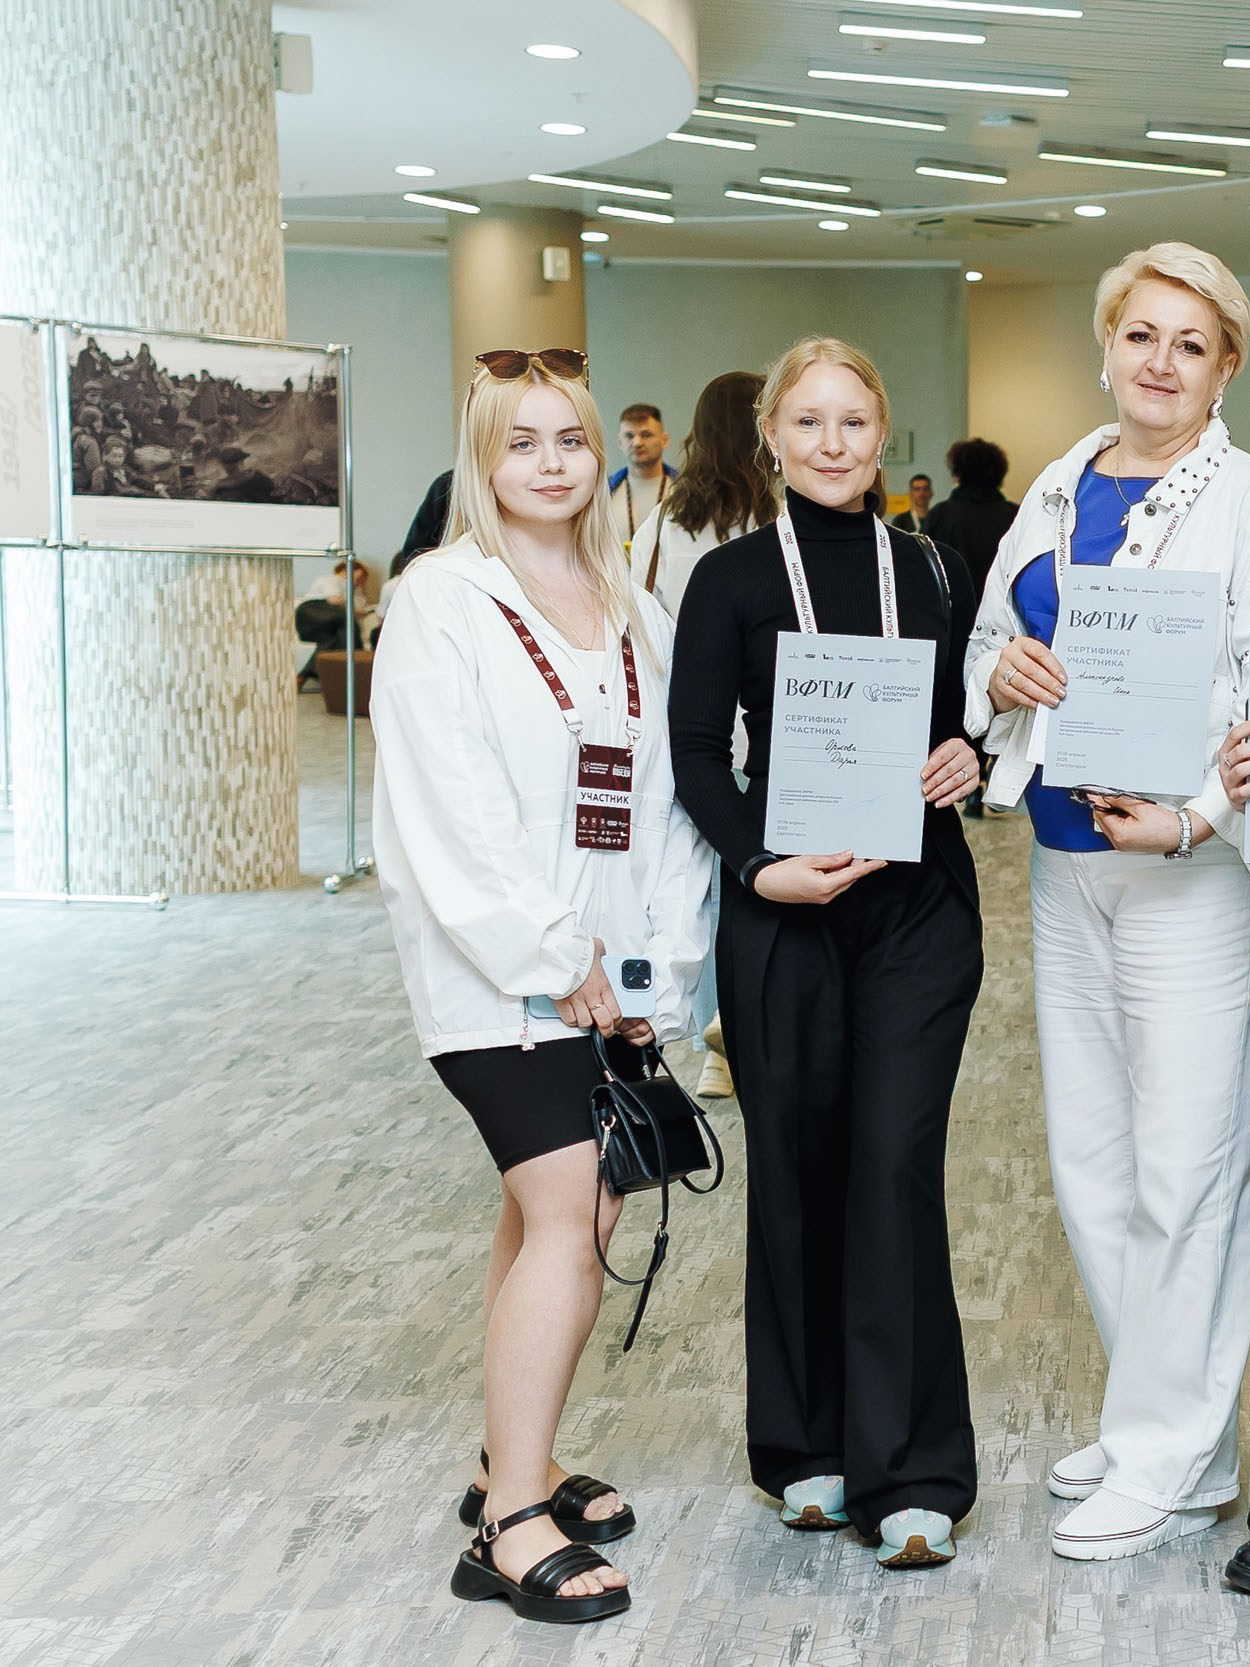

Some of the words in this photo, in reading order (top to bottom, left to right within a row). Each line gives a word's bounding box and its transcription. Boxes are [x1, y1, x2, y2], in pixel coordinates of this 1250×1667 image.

[1068, 609, 1140, 631] ВФТМ
[1067, 645, 1131, 656] СЕРТИФИКАТ
[1066, 657, 1124, 667] УЧАСТНИКА
[784, 678, 856, 699] ВФТМ
[784, 714, 849, 725] СЕРТИФИКАТ
[784, 725, 841, 736] УЧАСТНИКА
[580, 791, 630, 805] УЧАСТНИК
